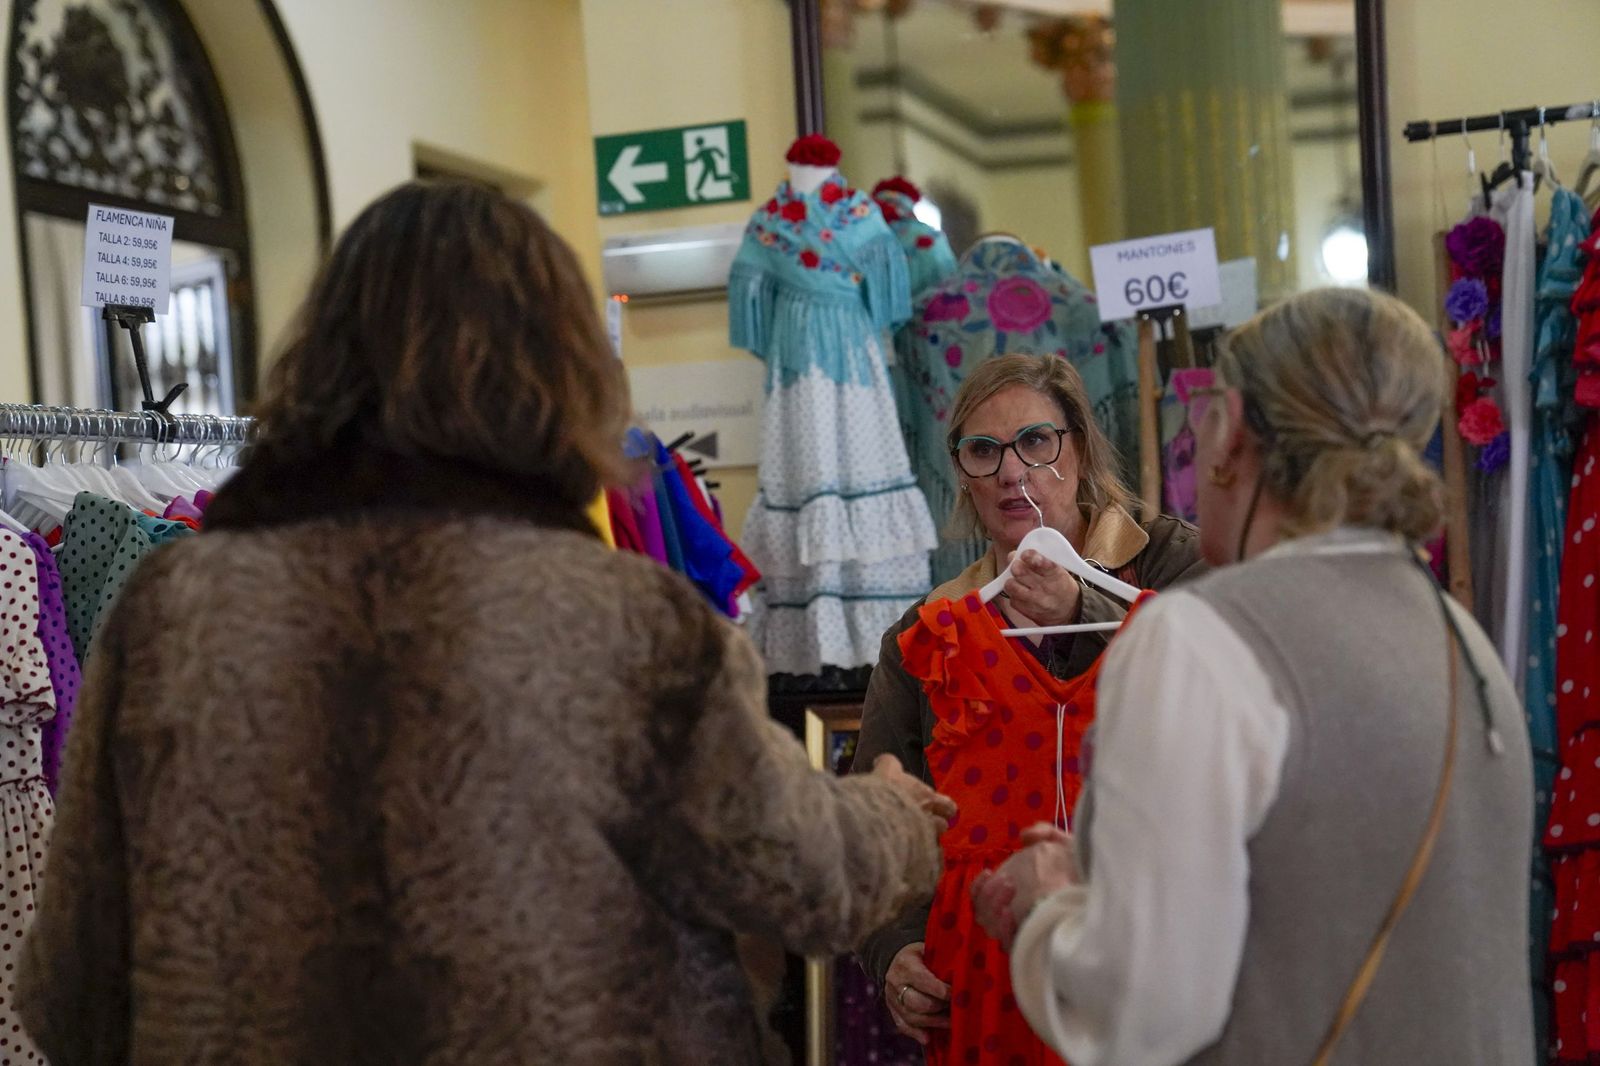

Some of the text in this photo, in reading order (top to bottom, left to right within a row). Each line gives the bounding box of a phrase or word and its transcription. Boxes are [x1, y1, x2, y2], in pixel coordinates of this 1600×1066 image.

[96, 210, 167, 231] FLAMENCA NIÑA
[99, 232, 158, 250] TALLA 2: 59,95€
[98, 252, 158, 269] TALLA 4: 59,95€
[1117, 241, 1196, 263] MANTONES
[96, 272, 157, 289] TALLA 6: 59,95€
[1124, 272, 1189, 306] 60€
[95, 292, 119, 304] TALLA
